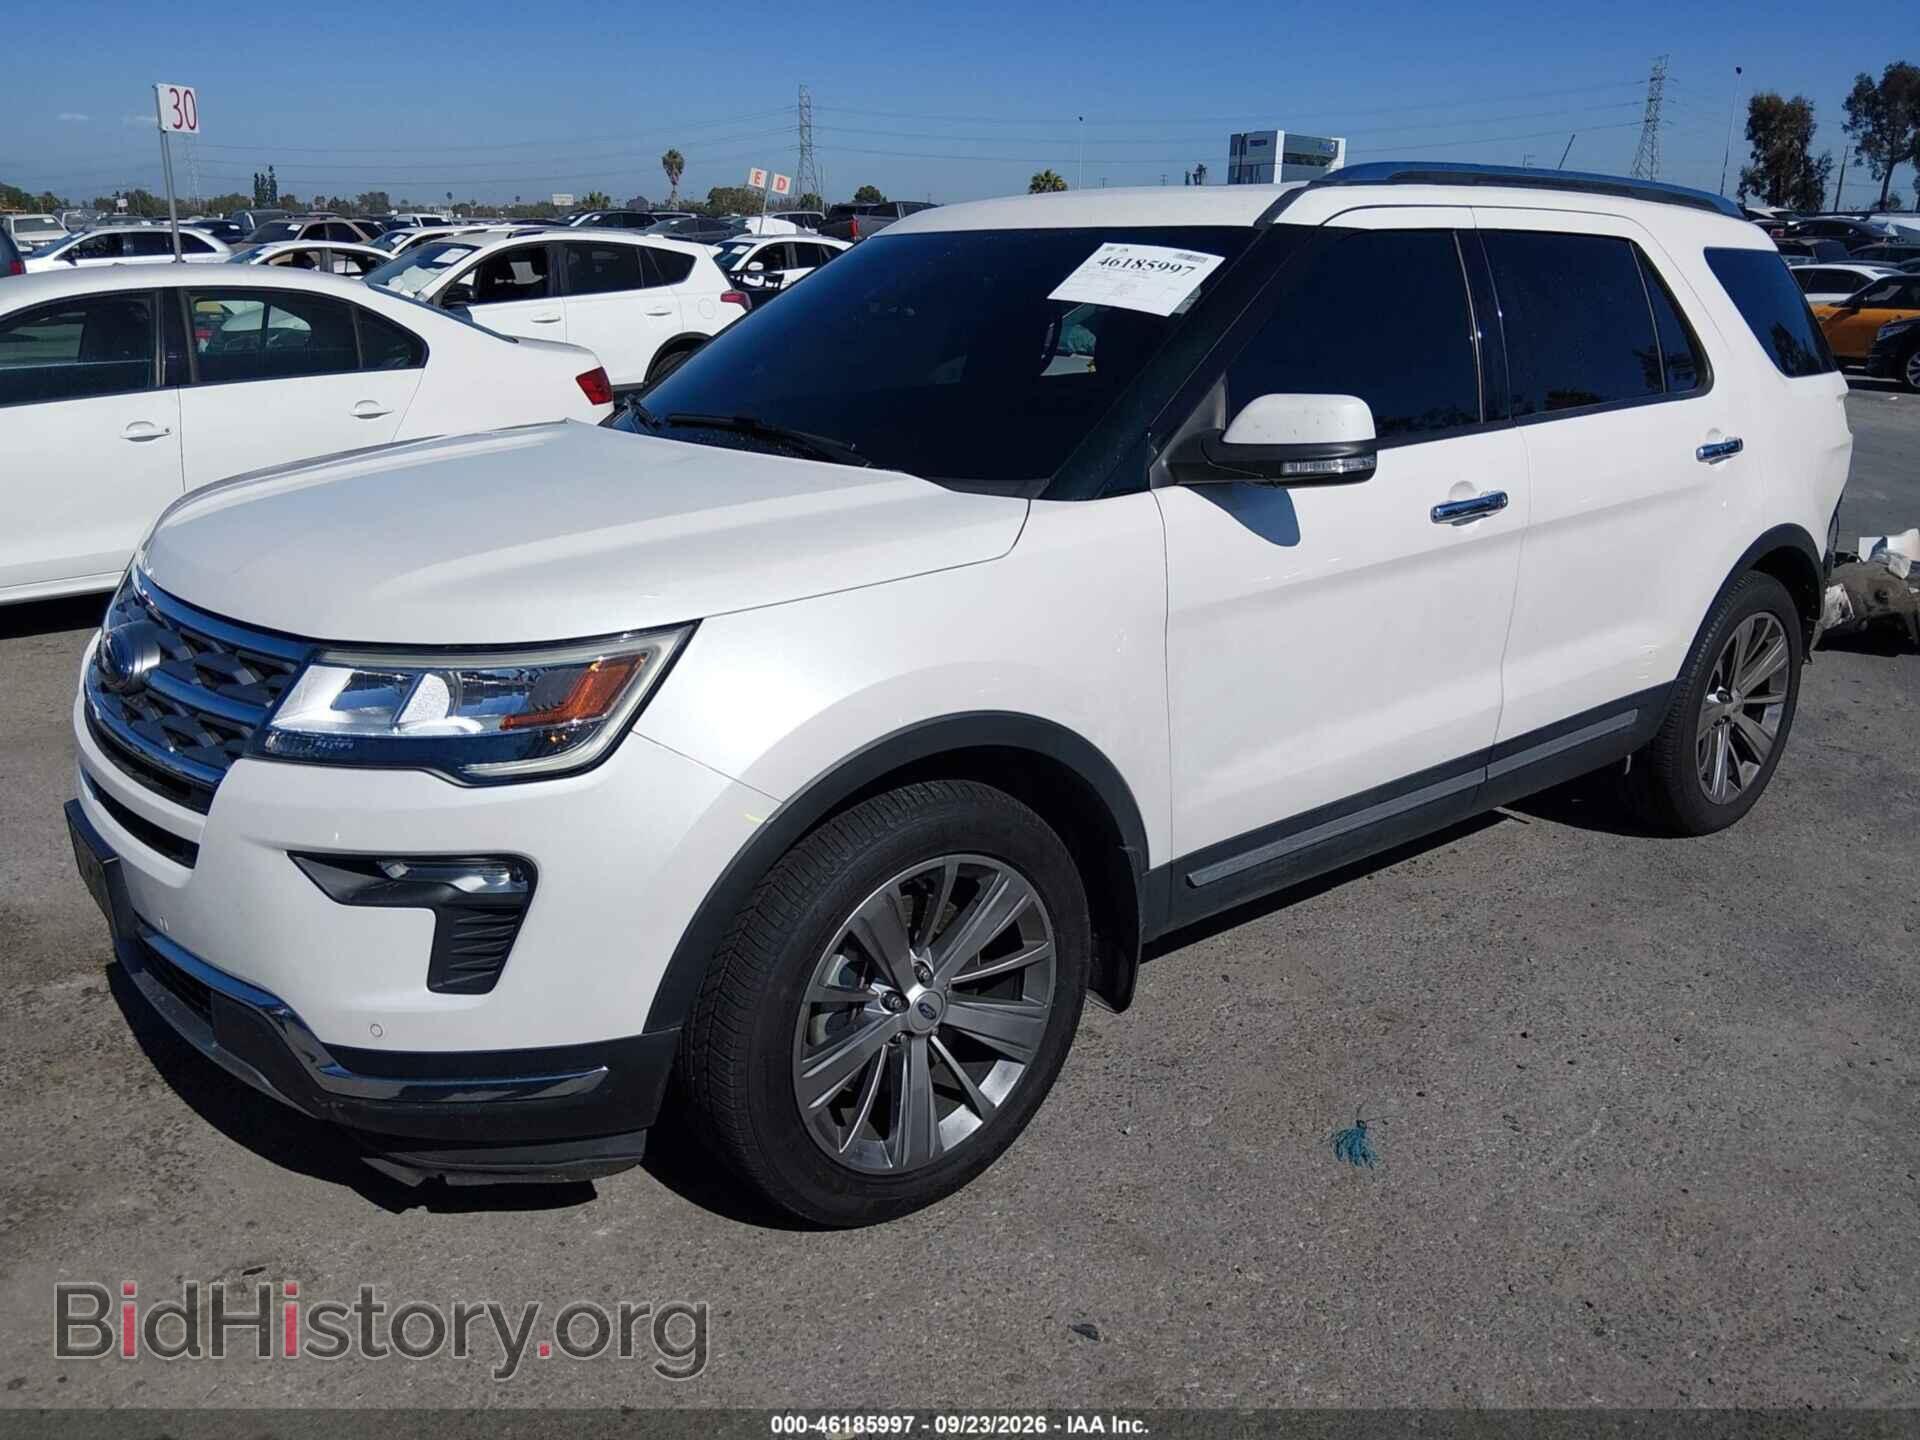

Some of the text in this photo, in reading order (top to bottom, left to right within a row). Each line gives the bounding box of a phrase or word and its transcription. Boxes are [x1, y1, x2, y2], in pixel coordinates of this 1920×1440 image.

[169, 87, 197, 130] 30
[777, 176, 787, 190] D
[1097, 255, 1196, 277] 46185997
